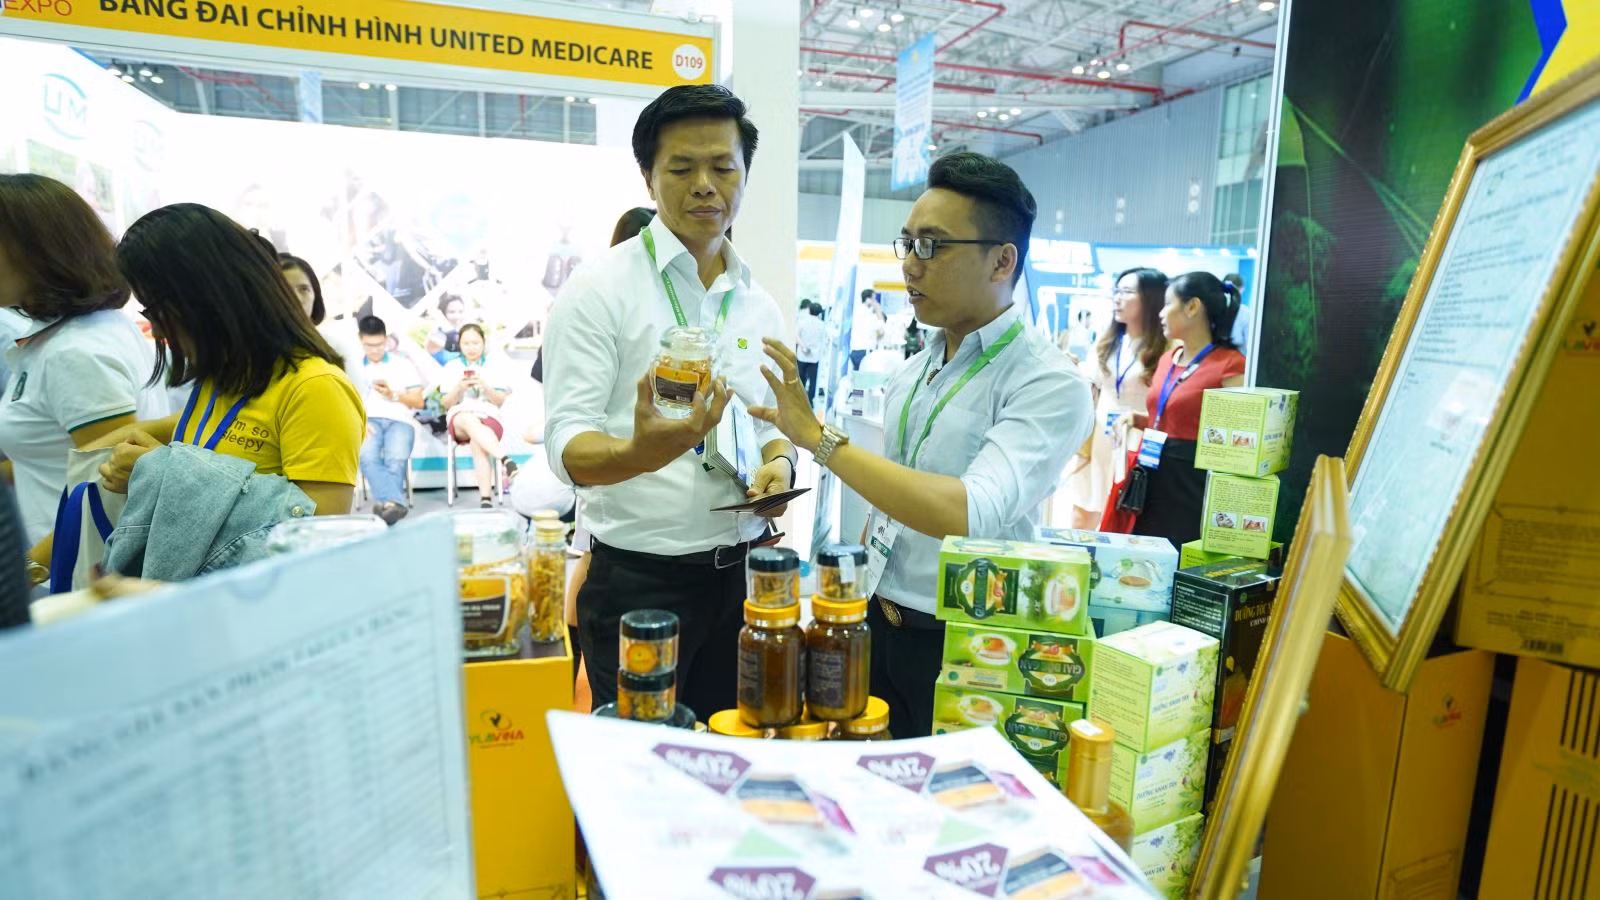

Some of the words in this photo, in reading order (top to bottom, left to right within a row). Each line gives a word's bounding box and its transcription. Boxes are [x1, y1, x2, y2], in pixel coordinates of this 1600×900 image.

[195, 2, 249, 27] ĐAI
[257, 5, 347, 37] CHỈNH
[355, 16, 422, 45] HÌNH
[430, 27, 524, 55] UNITED
[531, 38, 653, 70] MEDICARE
[675, 54, 703, 69] D109
[251, 426, 269, 438] so
